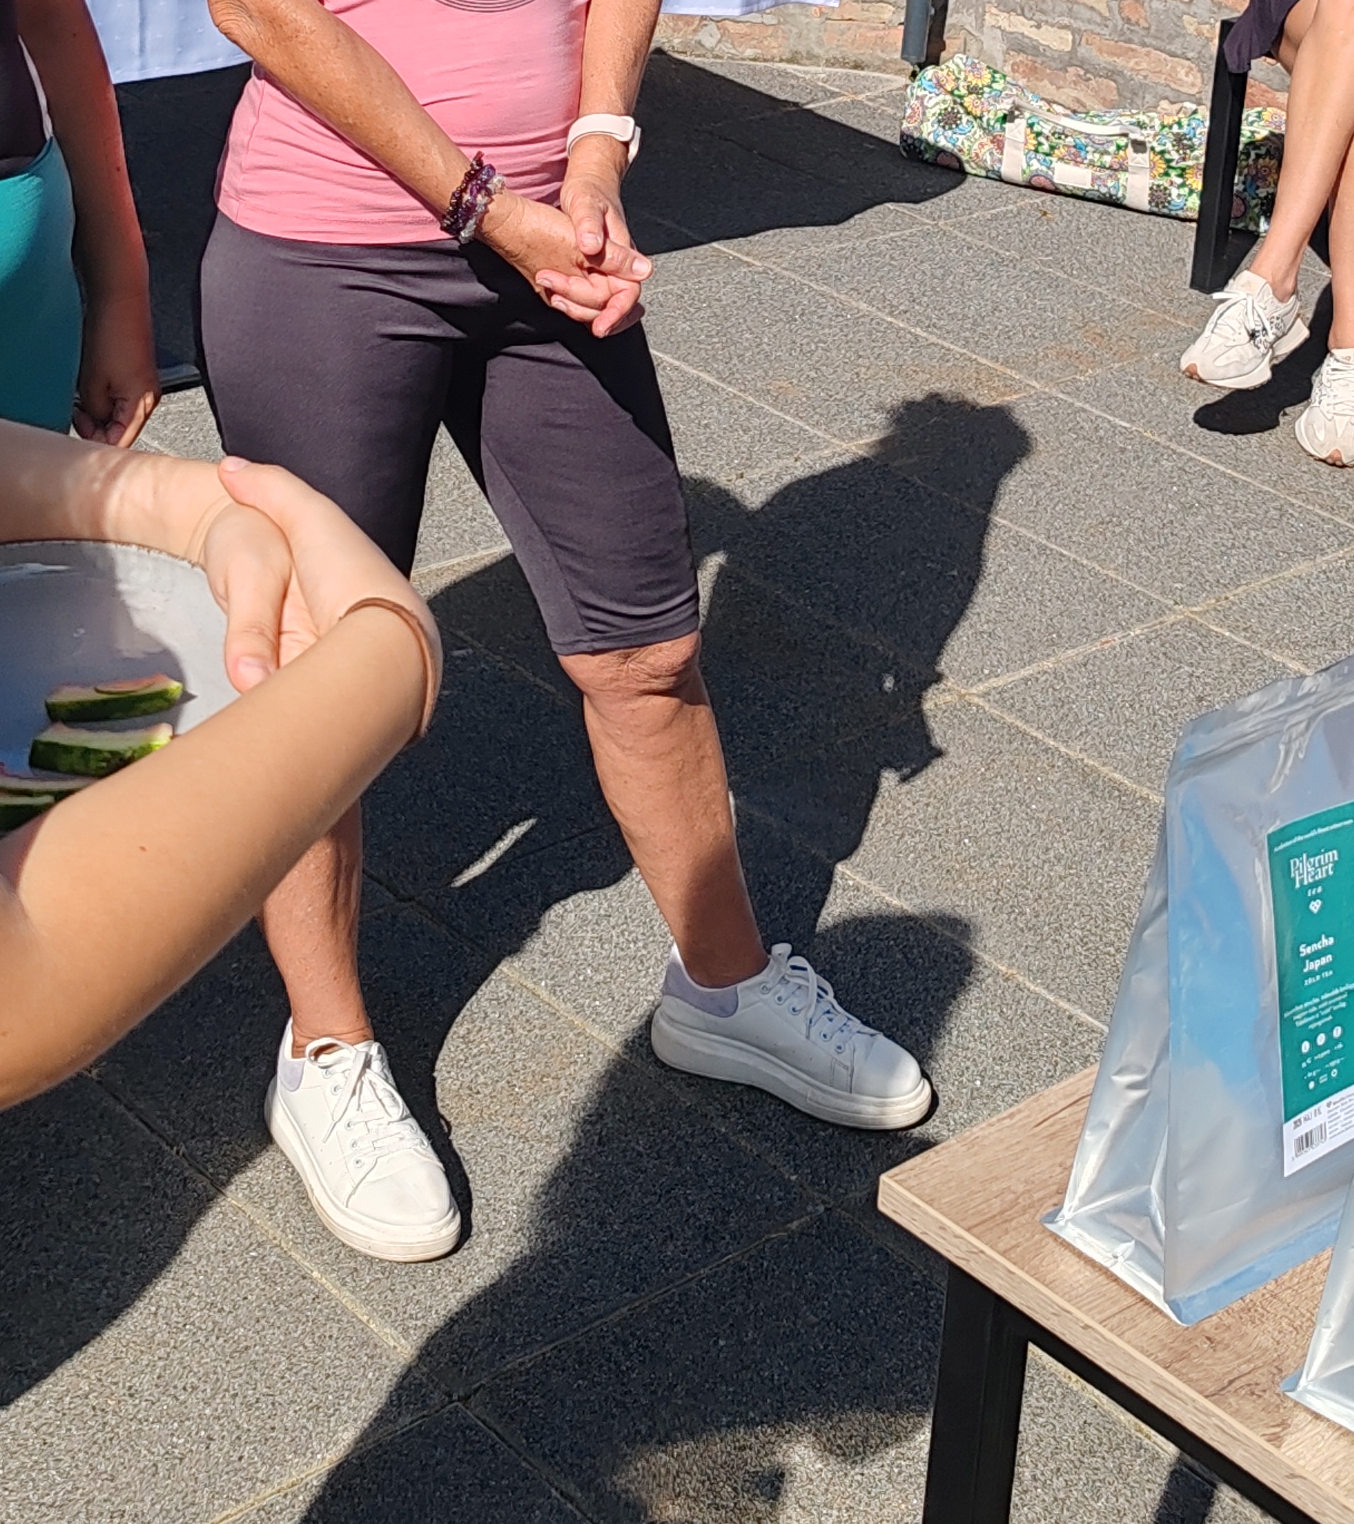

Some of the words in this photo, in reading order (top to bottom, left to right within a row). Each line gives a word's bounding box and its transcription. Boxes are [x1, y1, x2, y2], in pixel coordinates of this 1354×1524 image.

[1290, 849, 1339, 878] Pilgrim
[1295, 862, 1334, 889] Heart
[1299, 934, 1334, 957] Sencha
[1303, 954, 1333, 973] Japan
